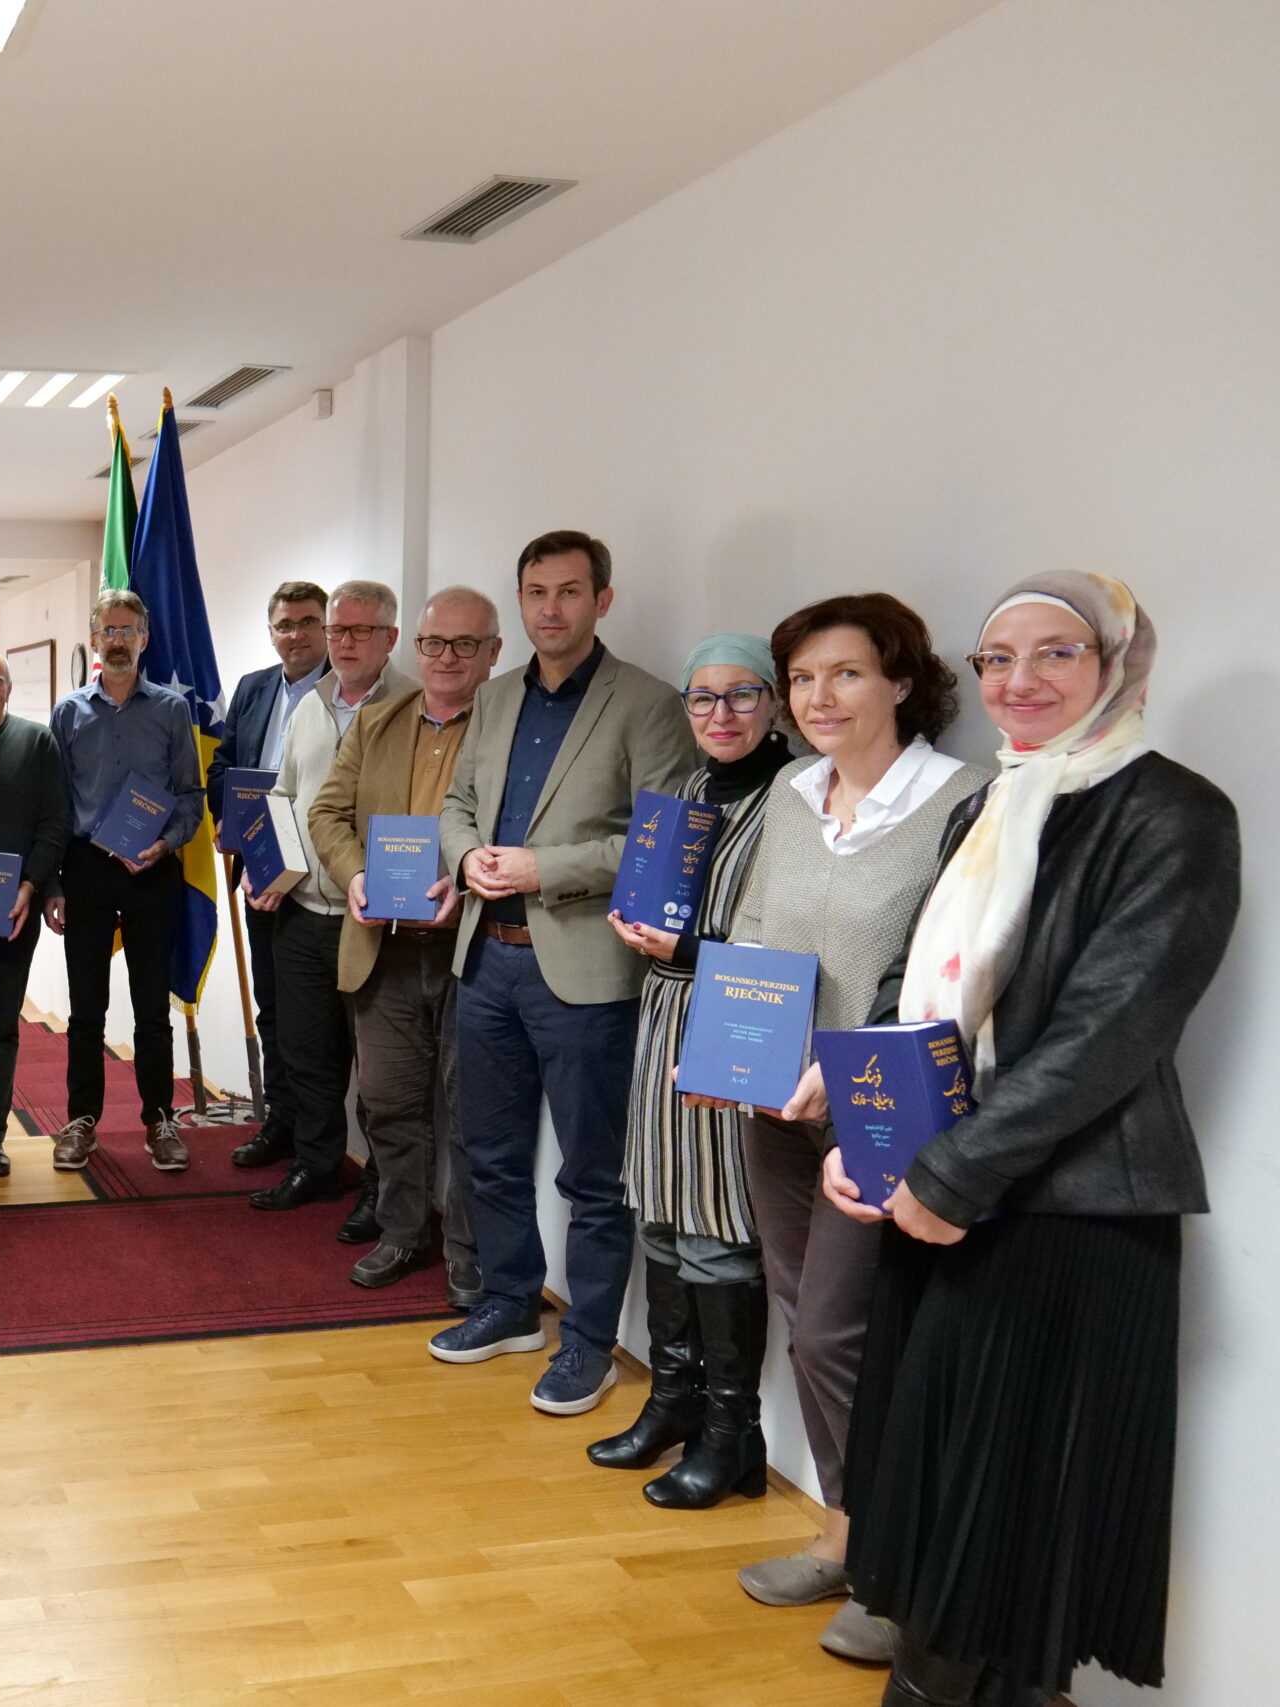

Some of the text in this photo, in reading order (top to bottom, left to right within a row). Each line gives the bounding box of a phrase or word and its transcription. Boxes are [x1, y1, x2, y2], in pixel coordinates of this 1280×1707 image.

[385, 844, 422, 853] RJEČNIK
[714, 973, 800, 992] BOSANSKO-PERZIJSKI
[725, 986, 784, 1005] RJEČNIK
[732, 1065, 746, 1073] Tom
[851, 1054, 883, 1087] فرهنگ
